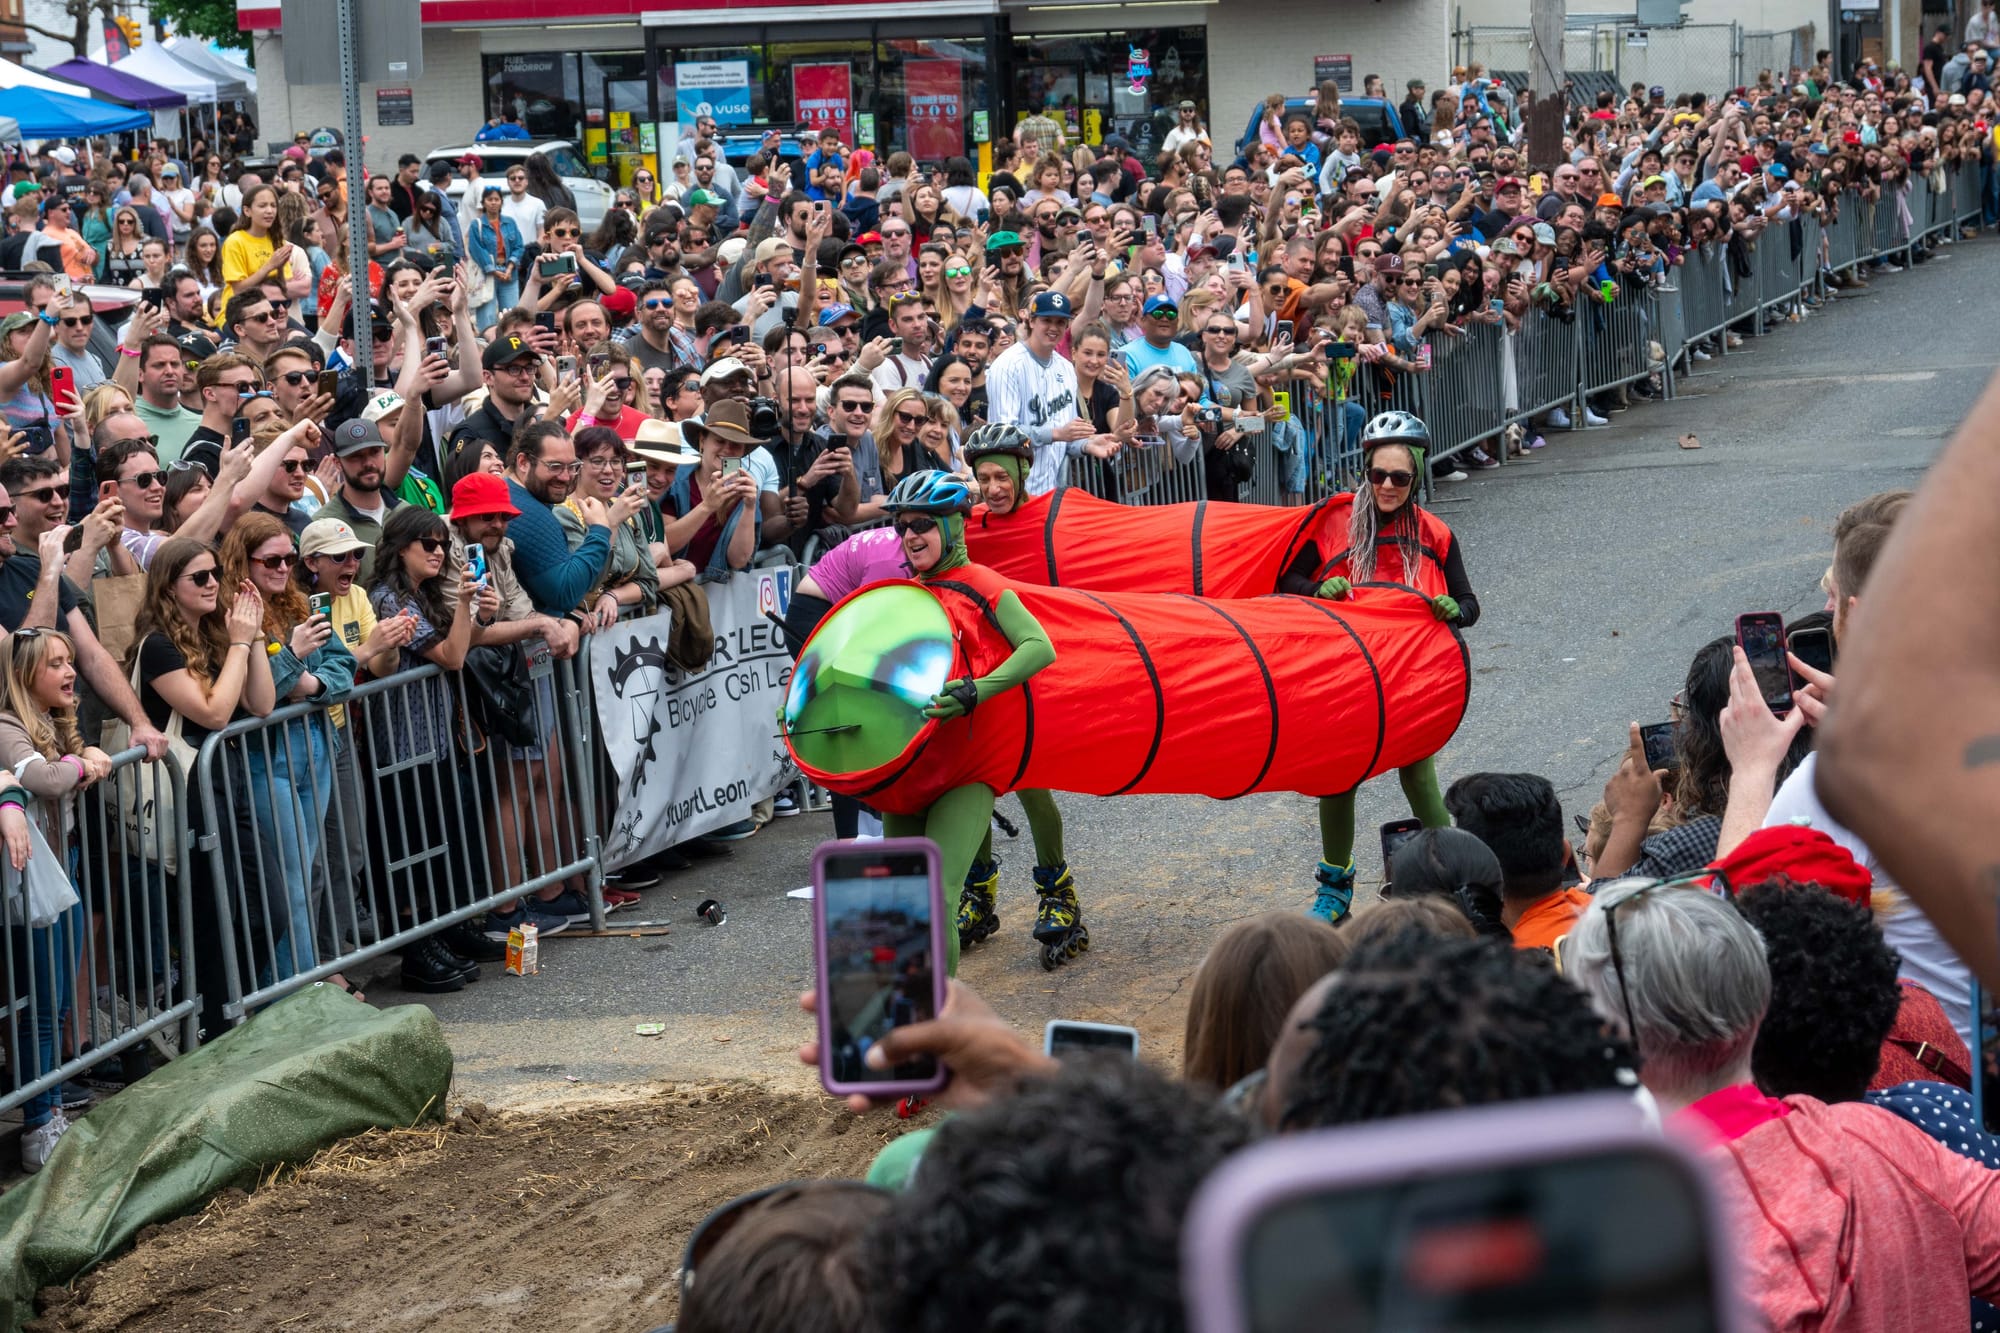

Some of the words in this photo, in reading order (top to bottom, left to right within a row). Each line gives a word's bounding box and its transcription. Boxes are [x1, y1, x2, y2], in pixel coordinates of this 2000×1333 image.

[503, 62, 553, 72] TOMORROW
[509, 337, 521, 350] P
[667, 684, 717, 729] Bicycle
[765, 661, 793, 688] La
